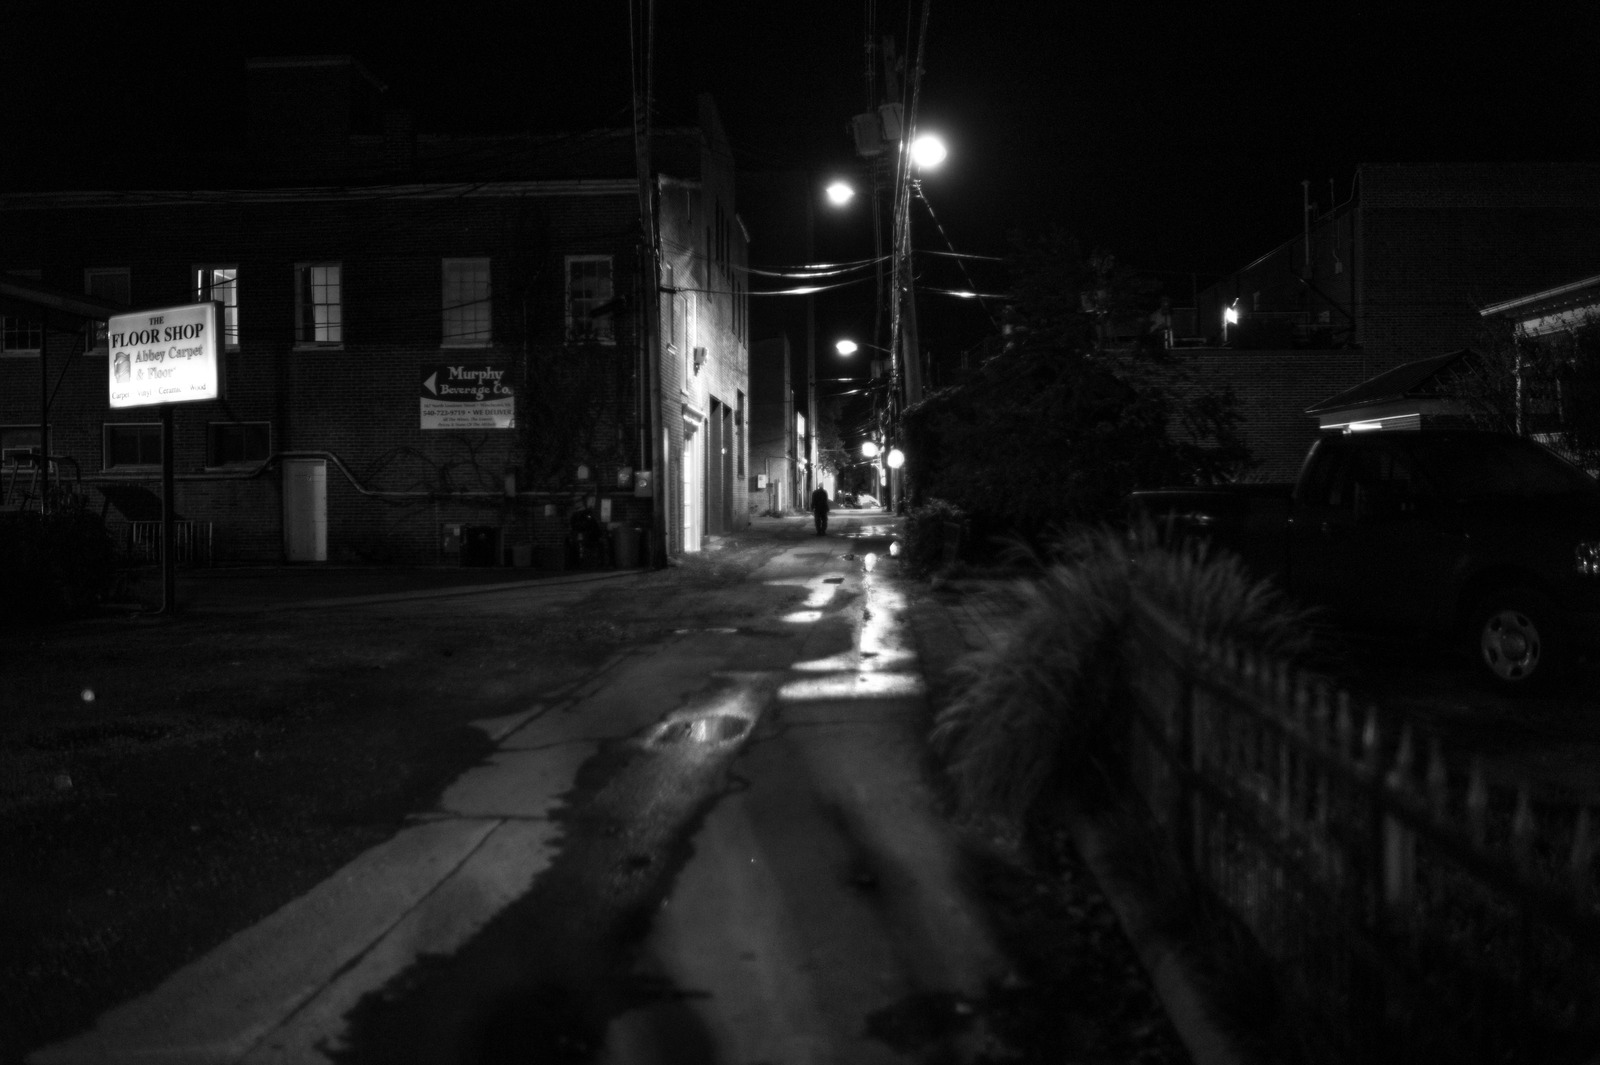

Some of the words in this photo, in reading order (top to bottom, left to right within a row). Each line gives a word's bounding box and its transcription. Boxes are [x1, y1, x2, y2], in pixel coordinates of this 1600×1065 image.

[149, 316, 164, 325] THE
[112, 328, 160, 348] FLOOR
[164, 323, 204, 342] SHOP
[135, 349, 166, 363] Abbey
[168, 345, 203, 360] Carpet
[136, 368, 144, 380] &
[147, 367, 174, 380] Floor
[446, 366, 505, 385] Murphy
[112, 391, 130, 400] Carpet
[439, 384, 491, 400] Beverage
[493, 383, 511, 394] Co.
